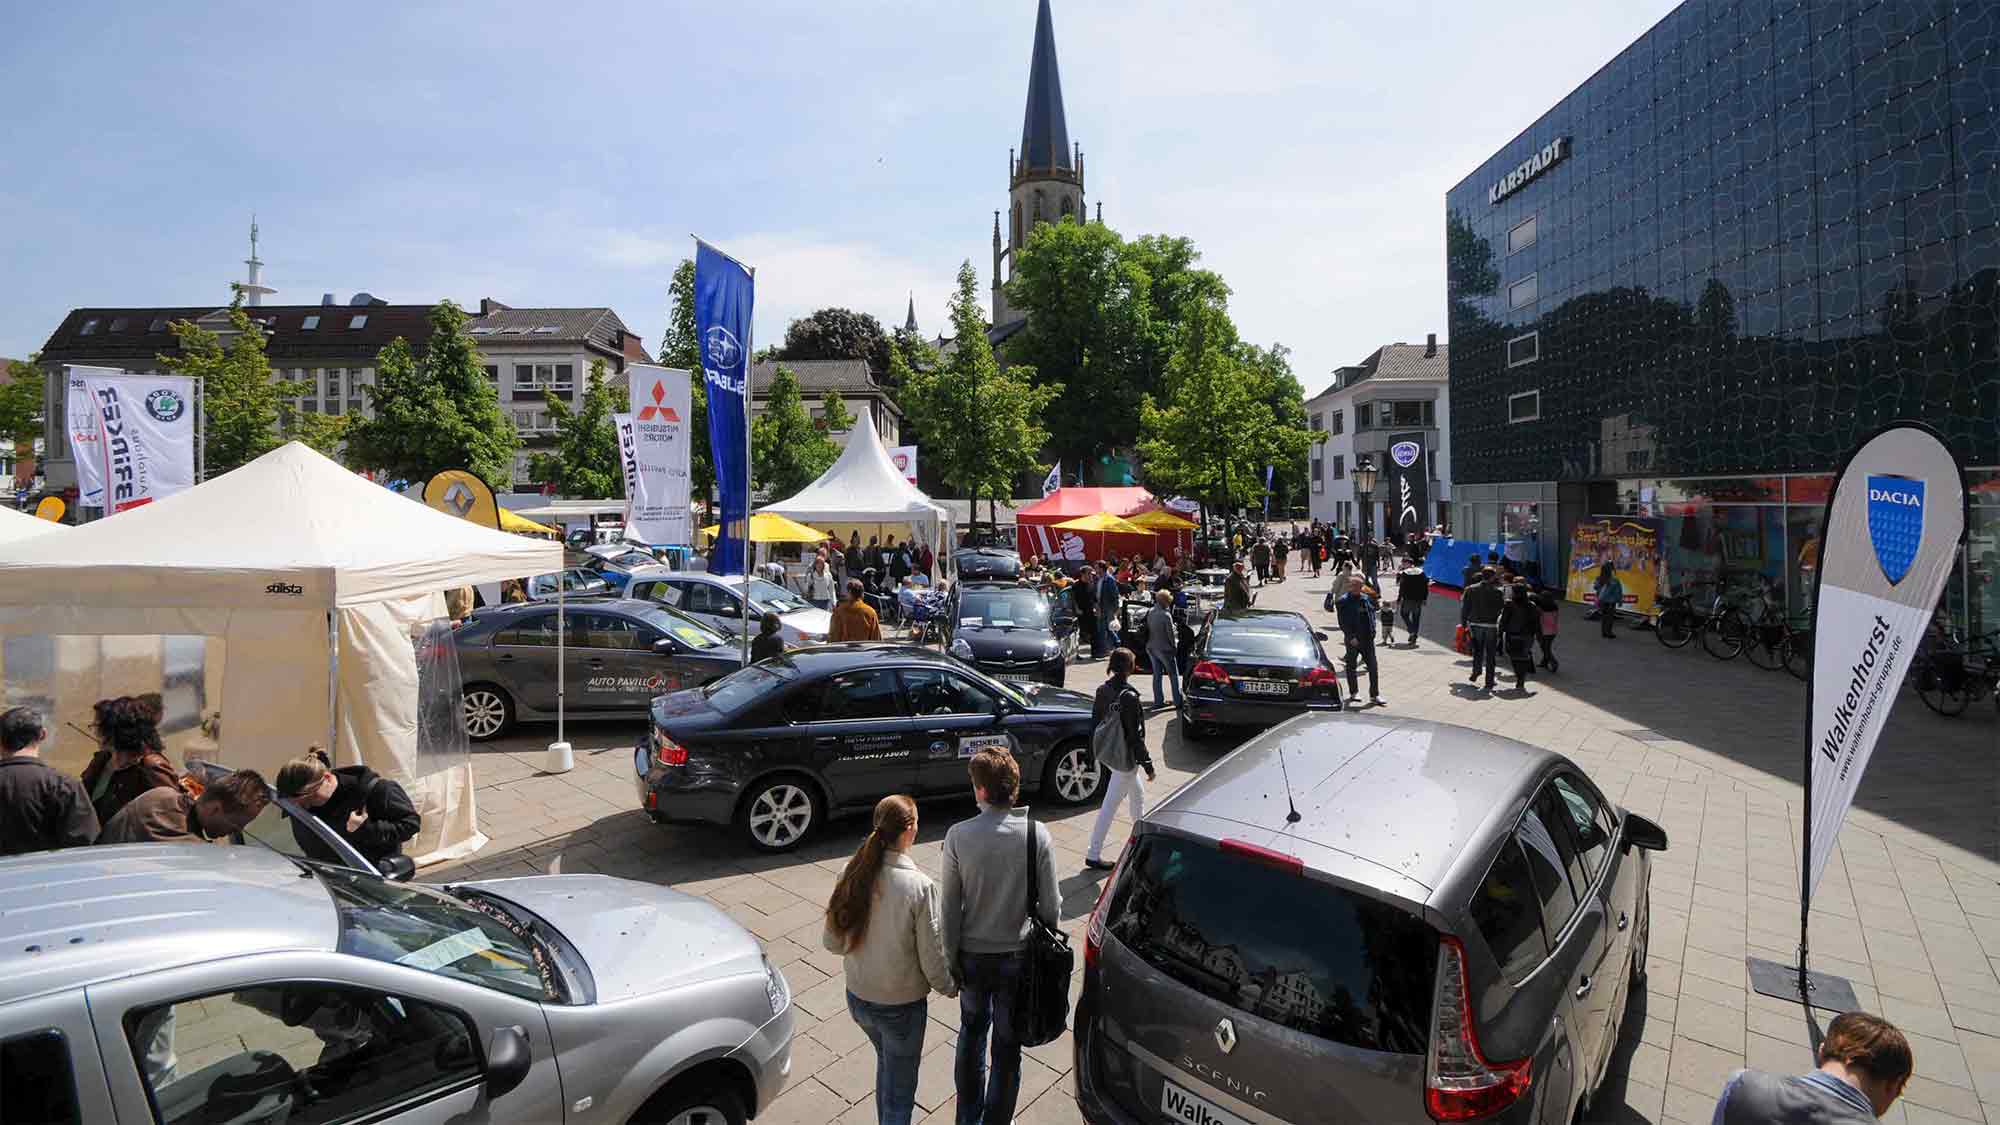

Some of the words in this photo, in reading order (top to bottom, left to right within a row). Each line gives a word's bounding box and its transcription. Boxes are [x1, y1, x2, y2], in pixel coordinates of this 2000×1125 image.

[1489, 137, 1564, 205] KARSTADT
[1870, 488, 1921, 507] DACIA
[587, 677, 615, 687] AUTO
[1822, 615, 1892, 764] Walkenhorst
[1839, 635, 1903, 782] www.walkenhorst-gruppe.de
